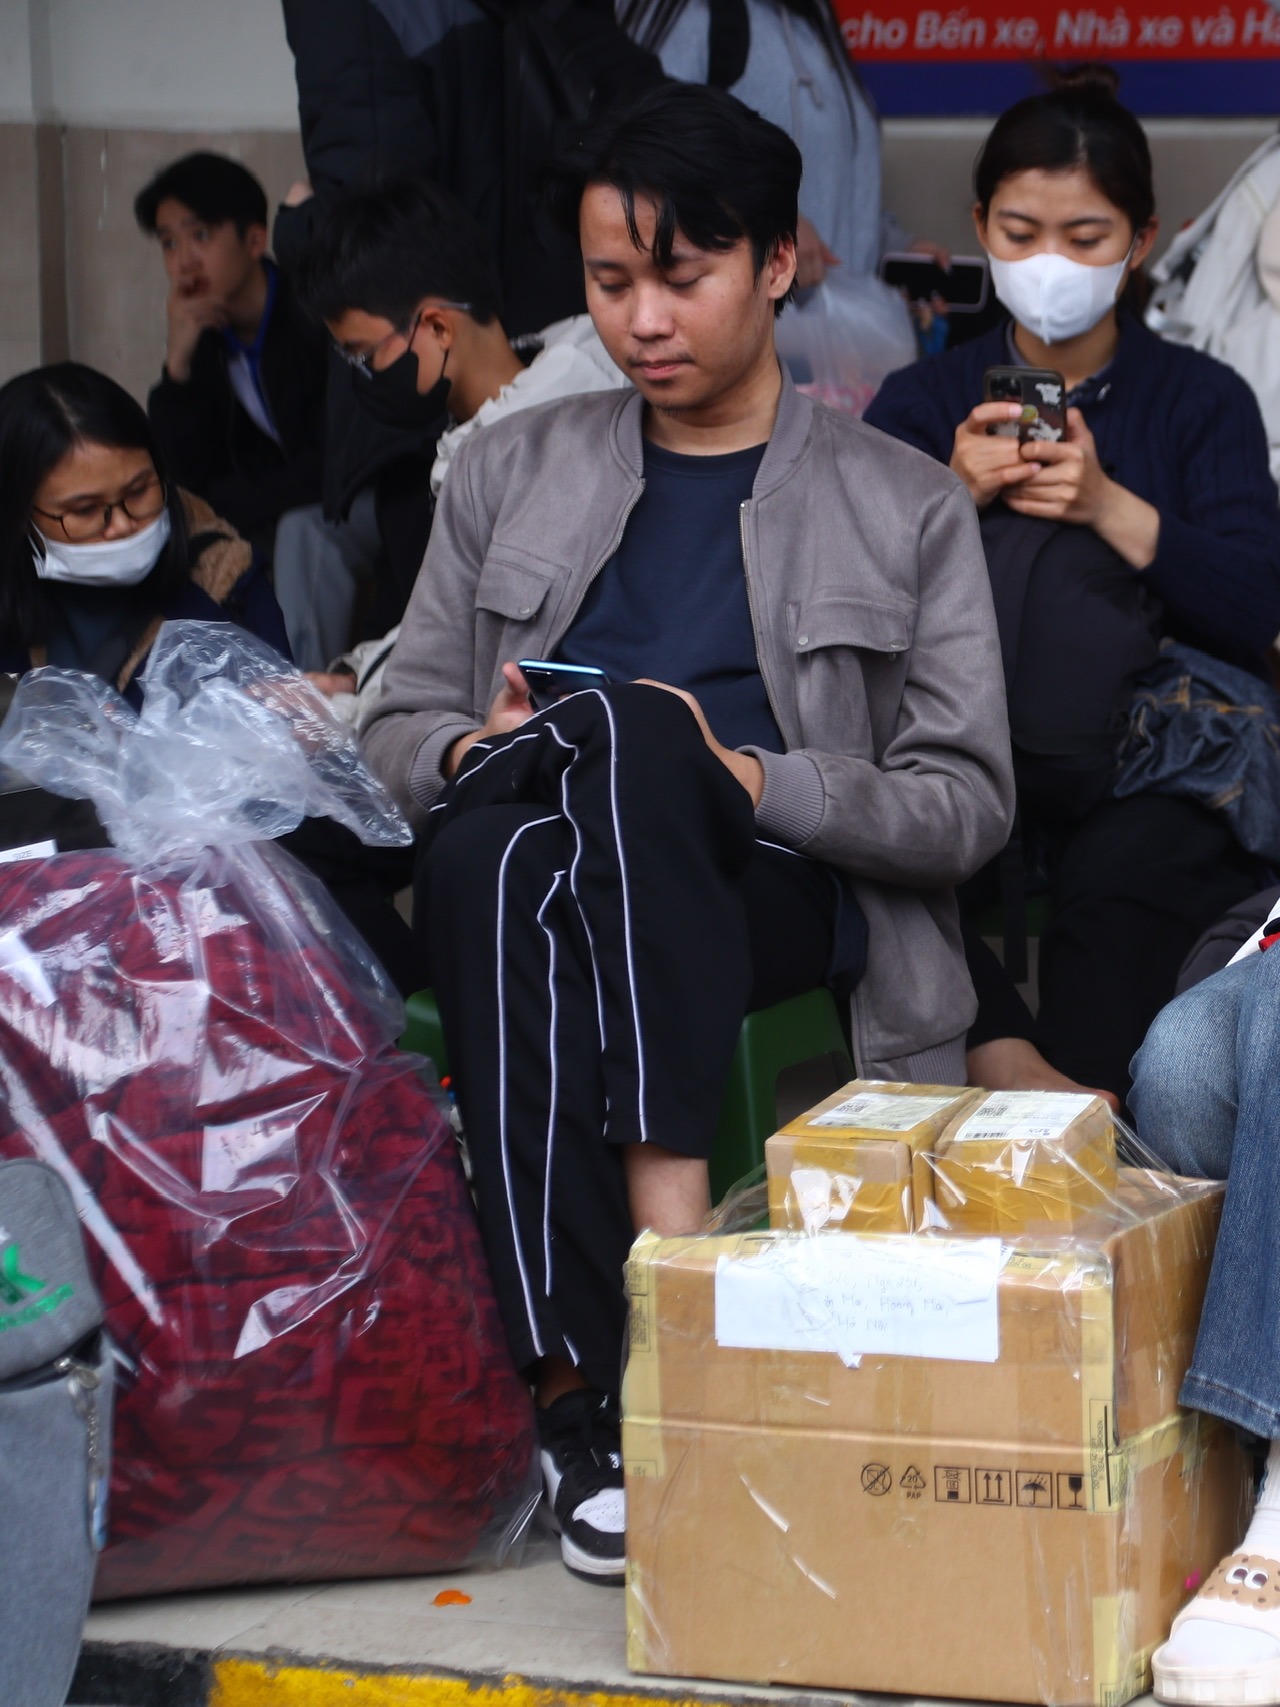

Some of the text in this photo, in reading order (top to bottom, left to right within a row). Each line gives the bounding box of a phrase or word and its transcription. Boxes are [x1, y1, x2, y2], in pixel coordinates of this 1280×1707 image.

[842, 9, 906, 48] cho
[914, 6, 987, 49] Bến
[1054, 9, 1129, 48] Nhà
[1138, 18, 1182, 47] xe
[1191, 5, 1236, 46] và
